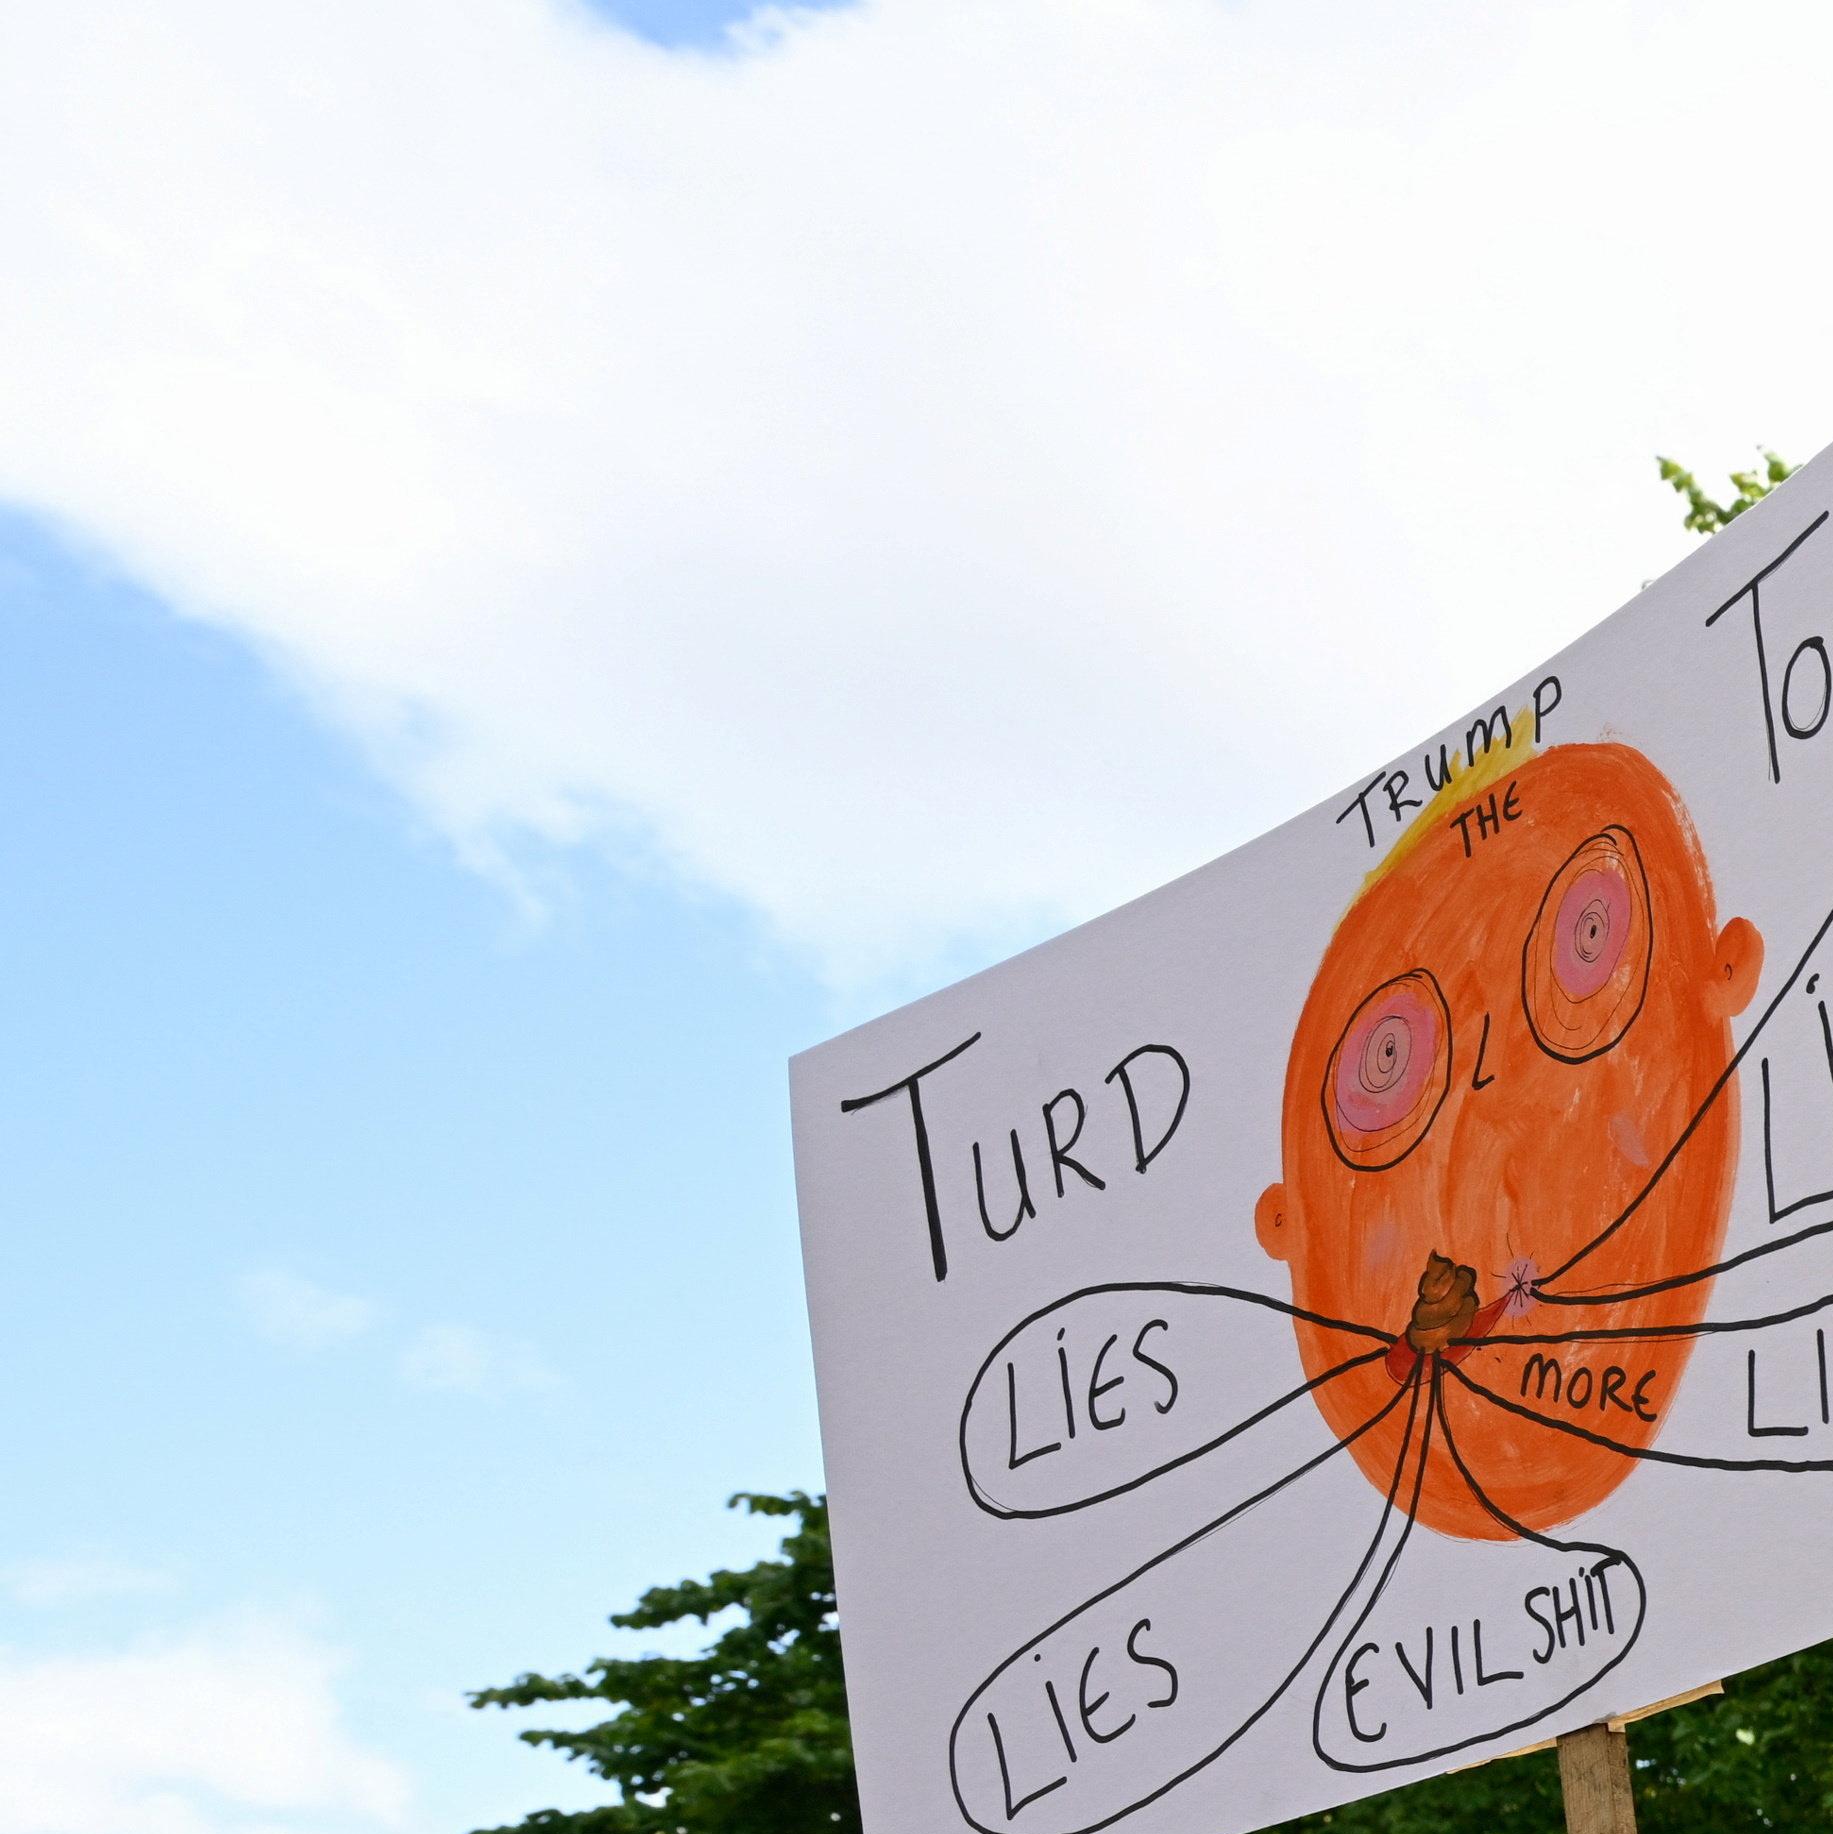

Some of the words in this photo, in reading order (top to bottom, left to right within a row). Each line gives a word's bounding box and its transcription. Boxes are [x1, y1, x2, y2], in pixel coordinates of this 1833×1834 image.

[1337, 676, 1562, 847] TRUMP
[1450, 782, 1524, 857] THE
[841, 1031, 1191, 1282] TURD
[1521, 1356, 1659, 1423] MORE
[1345, 1618, 1524, 1743] EVIL
